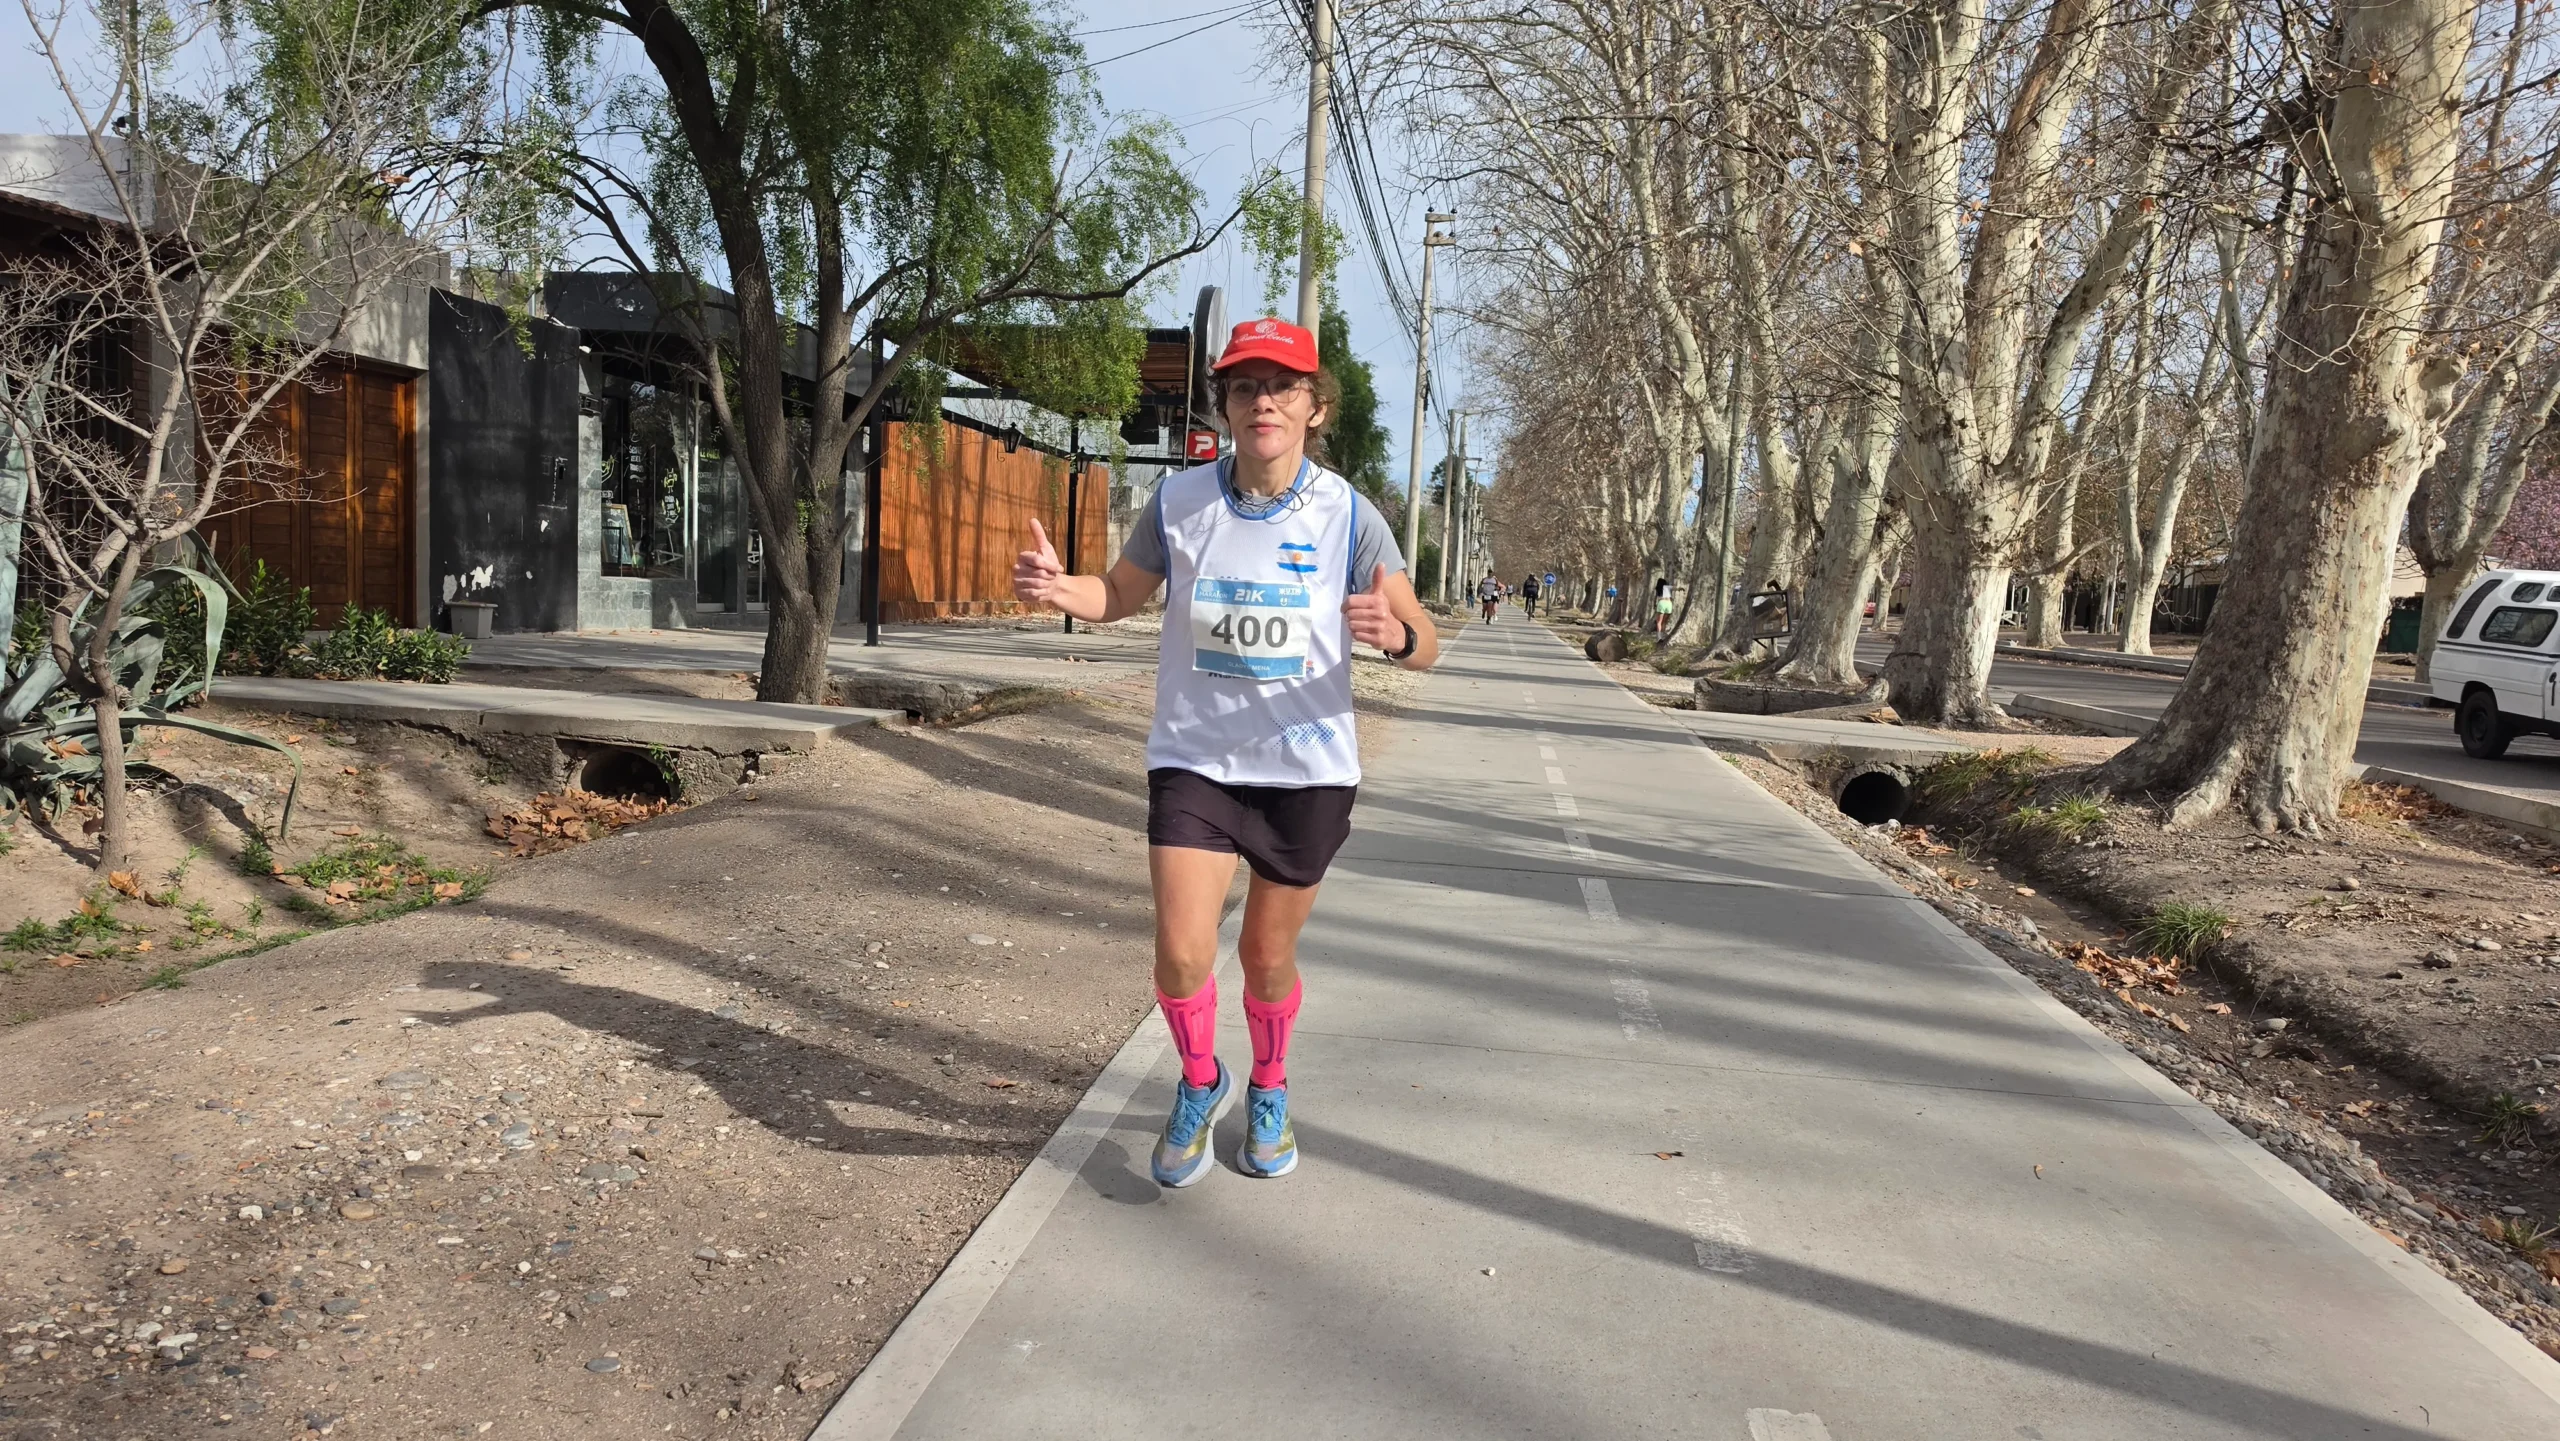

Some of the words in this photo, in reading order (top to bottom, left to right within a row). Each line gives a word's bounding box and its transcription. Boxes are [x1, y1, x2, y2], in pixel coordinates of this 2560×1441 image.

[1195, 435, 1214, 454] P
[1234, 588, 1266, 602] 21K
[1211, 614, 1288, 648] 400
